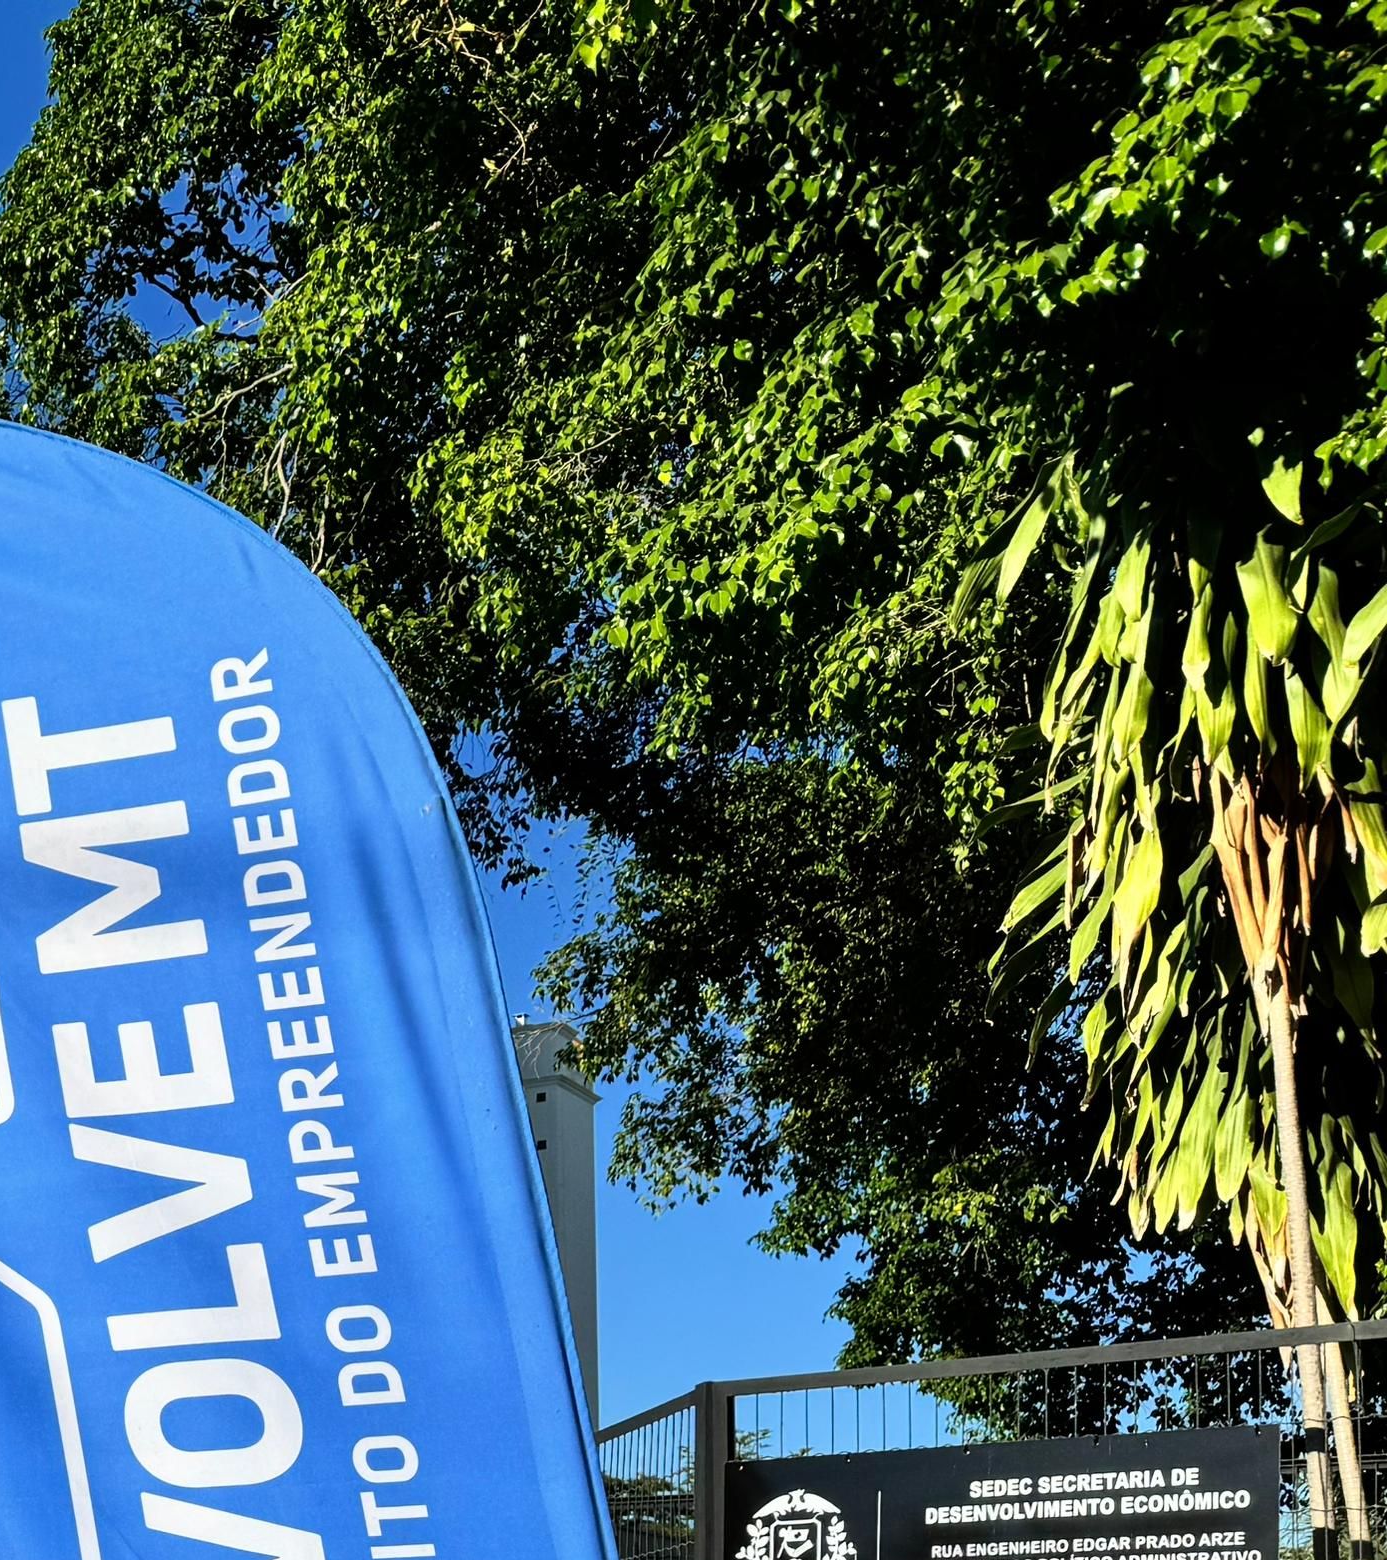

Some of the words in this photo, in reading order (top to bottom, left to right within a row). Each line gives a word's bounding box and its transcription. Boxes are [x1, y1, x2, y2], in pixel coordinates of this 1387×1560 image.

[1, 696, 209, 975] MT
[210, 647, 378, 1278] EMPREENDEDOR
[325, 1304, 407, 1407] DO
[925, 1497, 1115, 1525] DESENVOLVIMENTO
[1120, 1489, 1251, 1515] ECONÔMICO
[969, 1477, 1033, 1499] SEDEC
[1037, 1469, 1166, 1494] SECRETARIA
[1170, 1467, 1200, 1487] DE
[931, 1544, 963, 1559] RUA
[966, 1538, 1069, 1557] ENGENHEIRO
[1072, 1536, 1131, 1552] EDGAR
[1135, 1533, 1196, 1550] PRADO
[1198, 1531, 1246, 1547] ARZE
